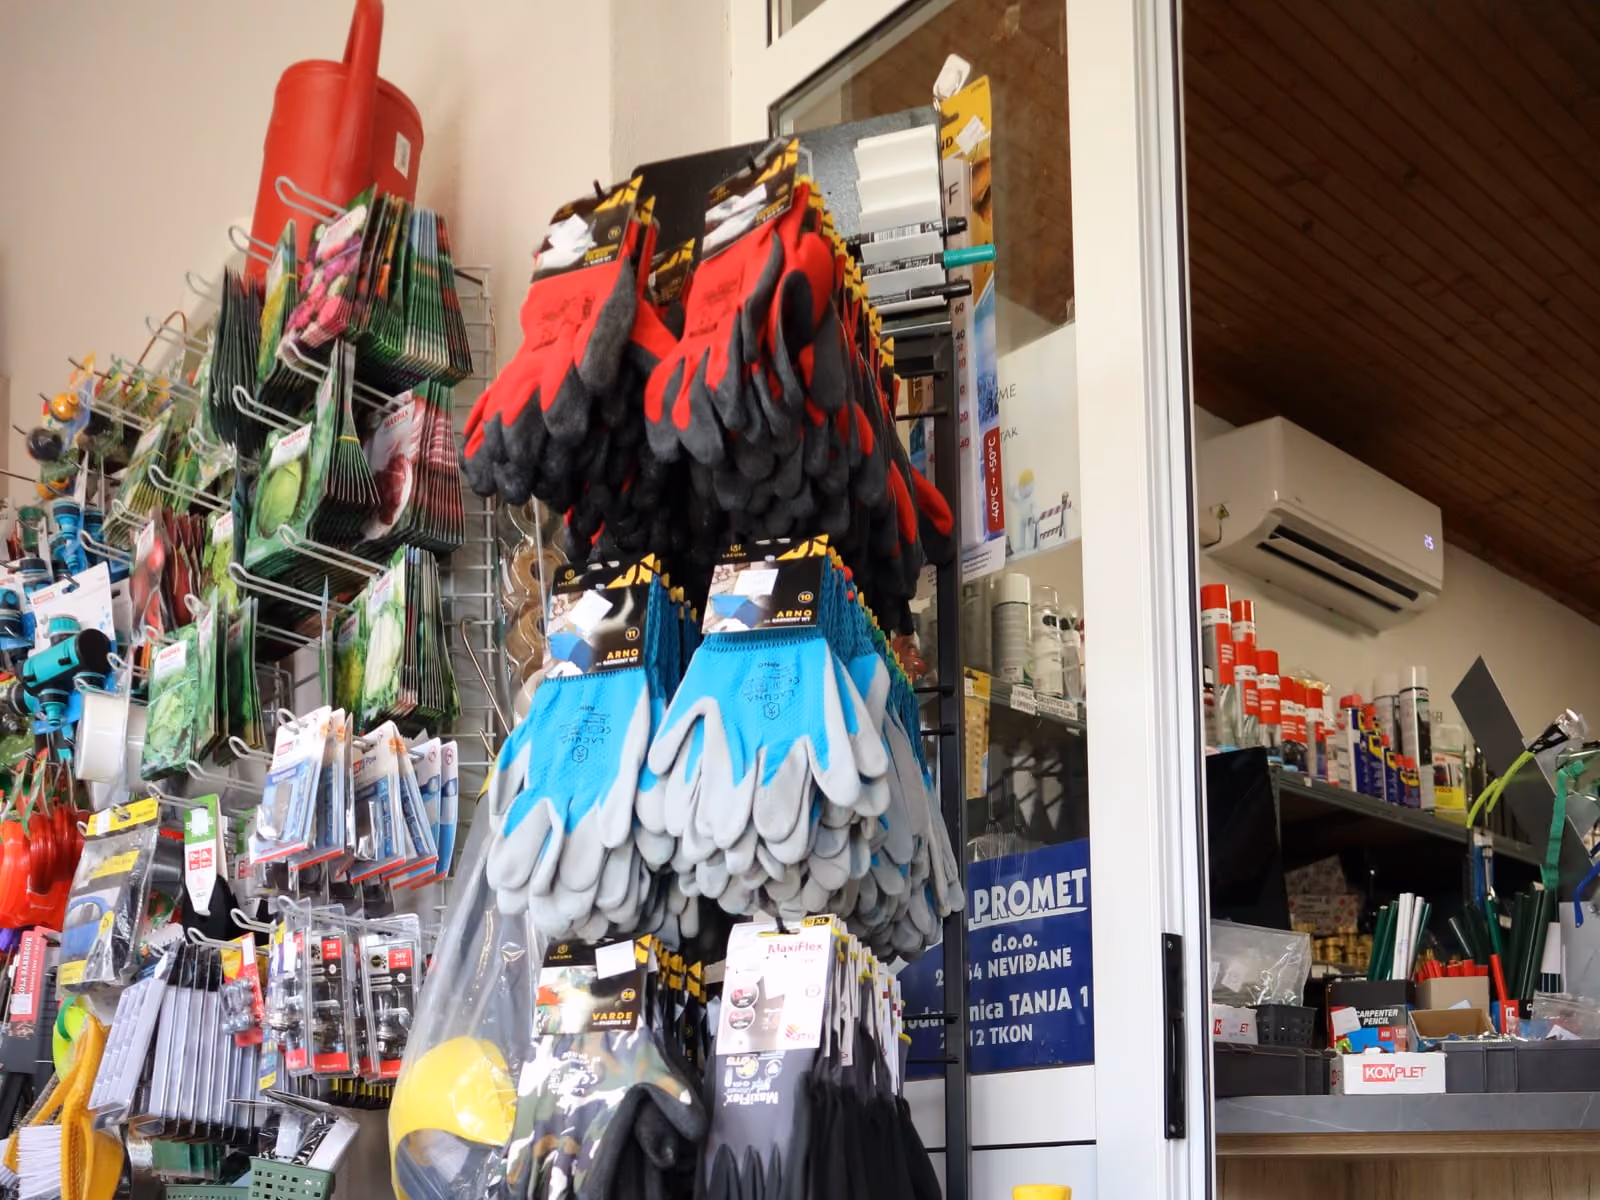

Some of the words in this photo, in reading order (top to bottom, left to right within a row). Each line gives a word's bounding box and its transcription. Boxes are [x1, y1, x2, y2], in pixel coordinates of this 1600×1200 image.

[776, 609, 812, 619] ARNO
[606, 648, 639, 660] ARNO
[973, 868, 1088, 924] PROMET
[767, 941, 824, 954] MaxiFlex
[991, 933, 1039, 953] d.o.o.
[988, 947, 1073, 980] NEVIĐANE
[1009, 987, 1073, 1018] TANJA
[1080, 985, 1090, 1009] 1
[592, 1011, 634, 1021] VARDE
[1356, 1008, 1398, 1018] CARPENTER
[1363, 1017, 1390, 1025] PENCIL
[990, 1023, 1034, 1046] TKON
[1365, 1066, 1427, 1079] KOMPLET
[726, 1091, 779, 1105] MaxiFlex
